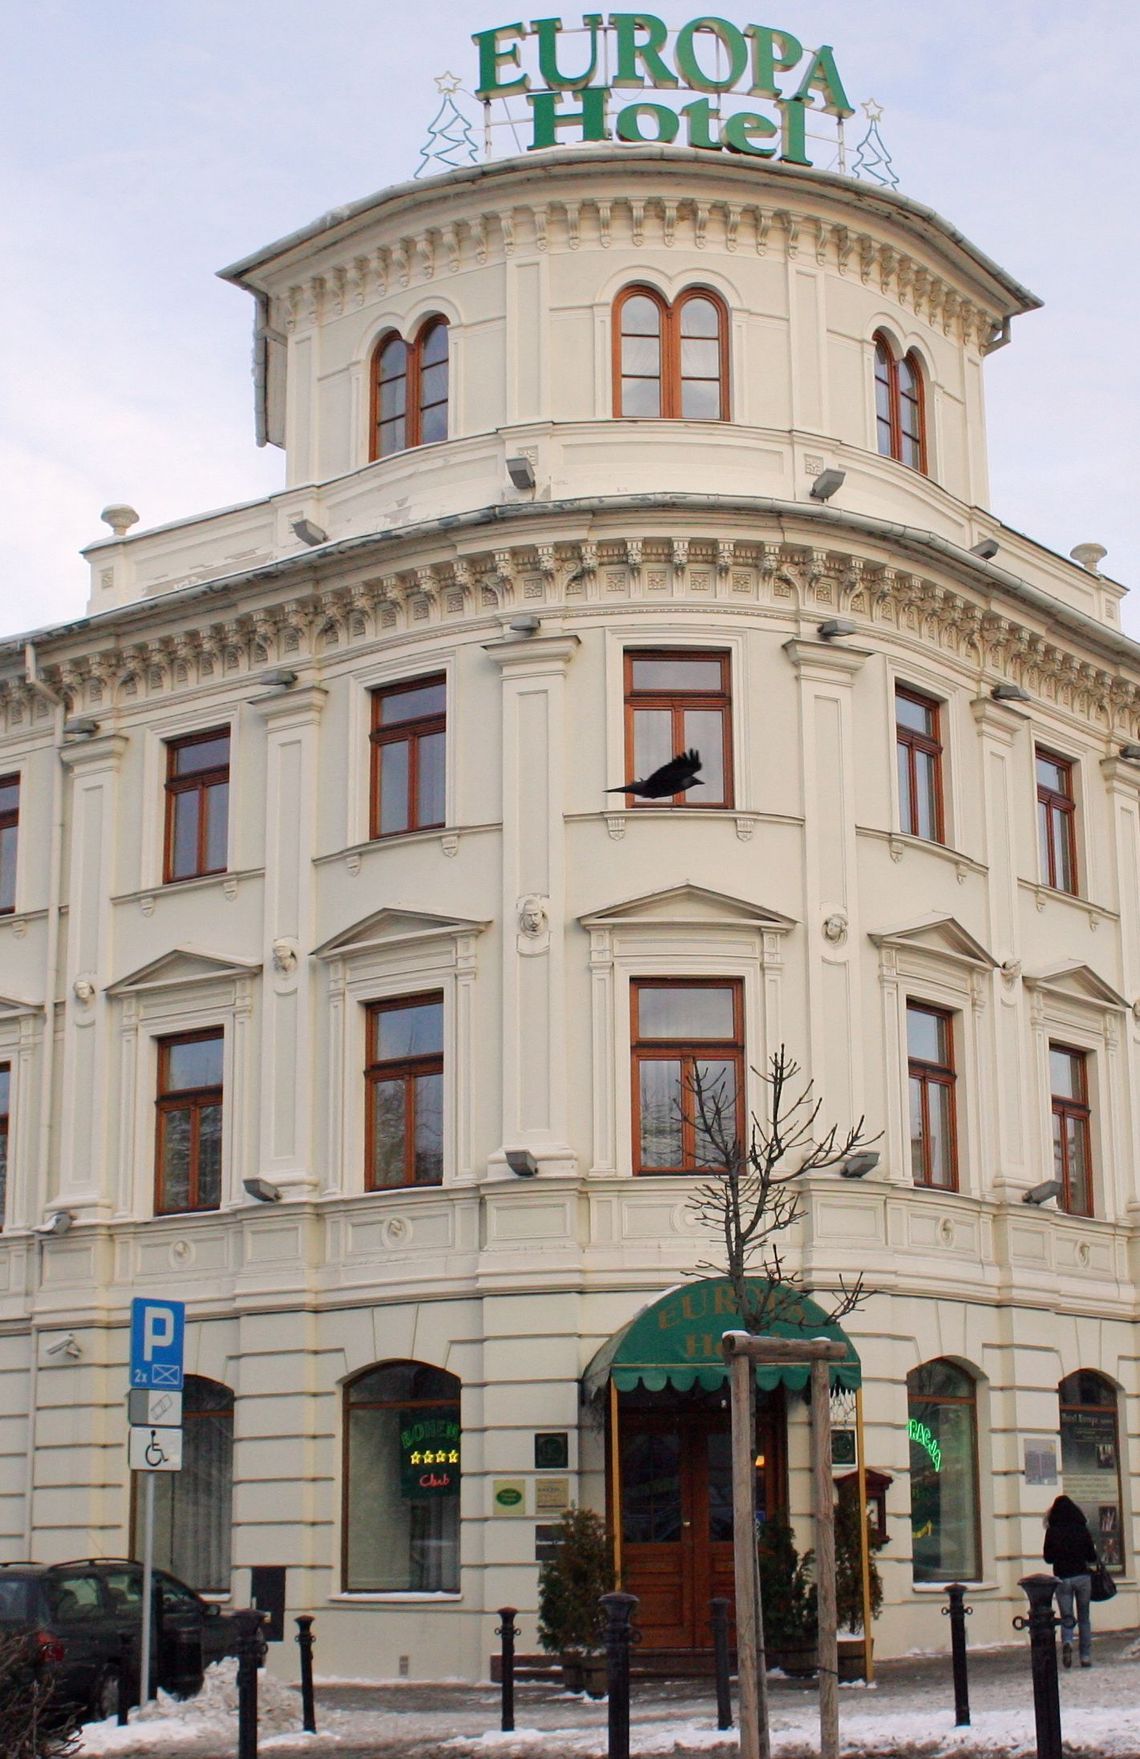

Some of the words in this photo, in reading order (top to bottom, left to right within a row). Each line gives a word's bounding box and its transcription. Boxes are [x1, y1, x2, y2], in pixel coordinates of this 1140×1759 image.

[471, 13, 856, 119] EUROPA
[525, 88, 813, 167] Hotel
[143, 1306, 174, 1361] P
[134, 1369, 148, 1383] 2x
[420, 1473, 449, 1488] Club
